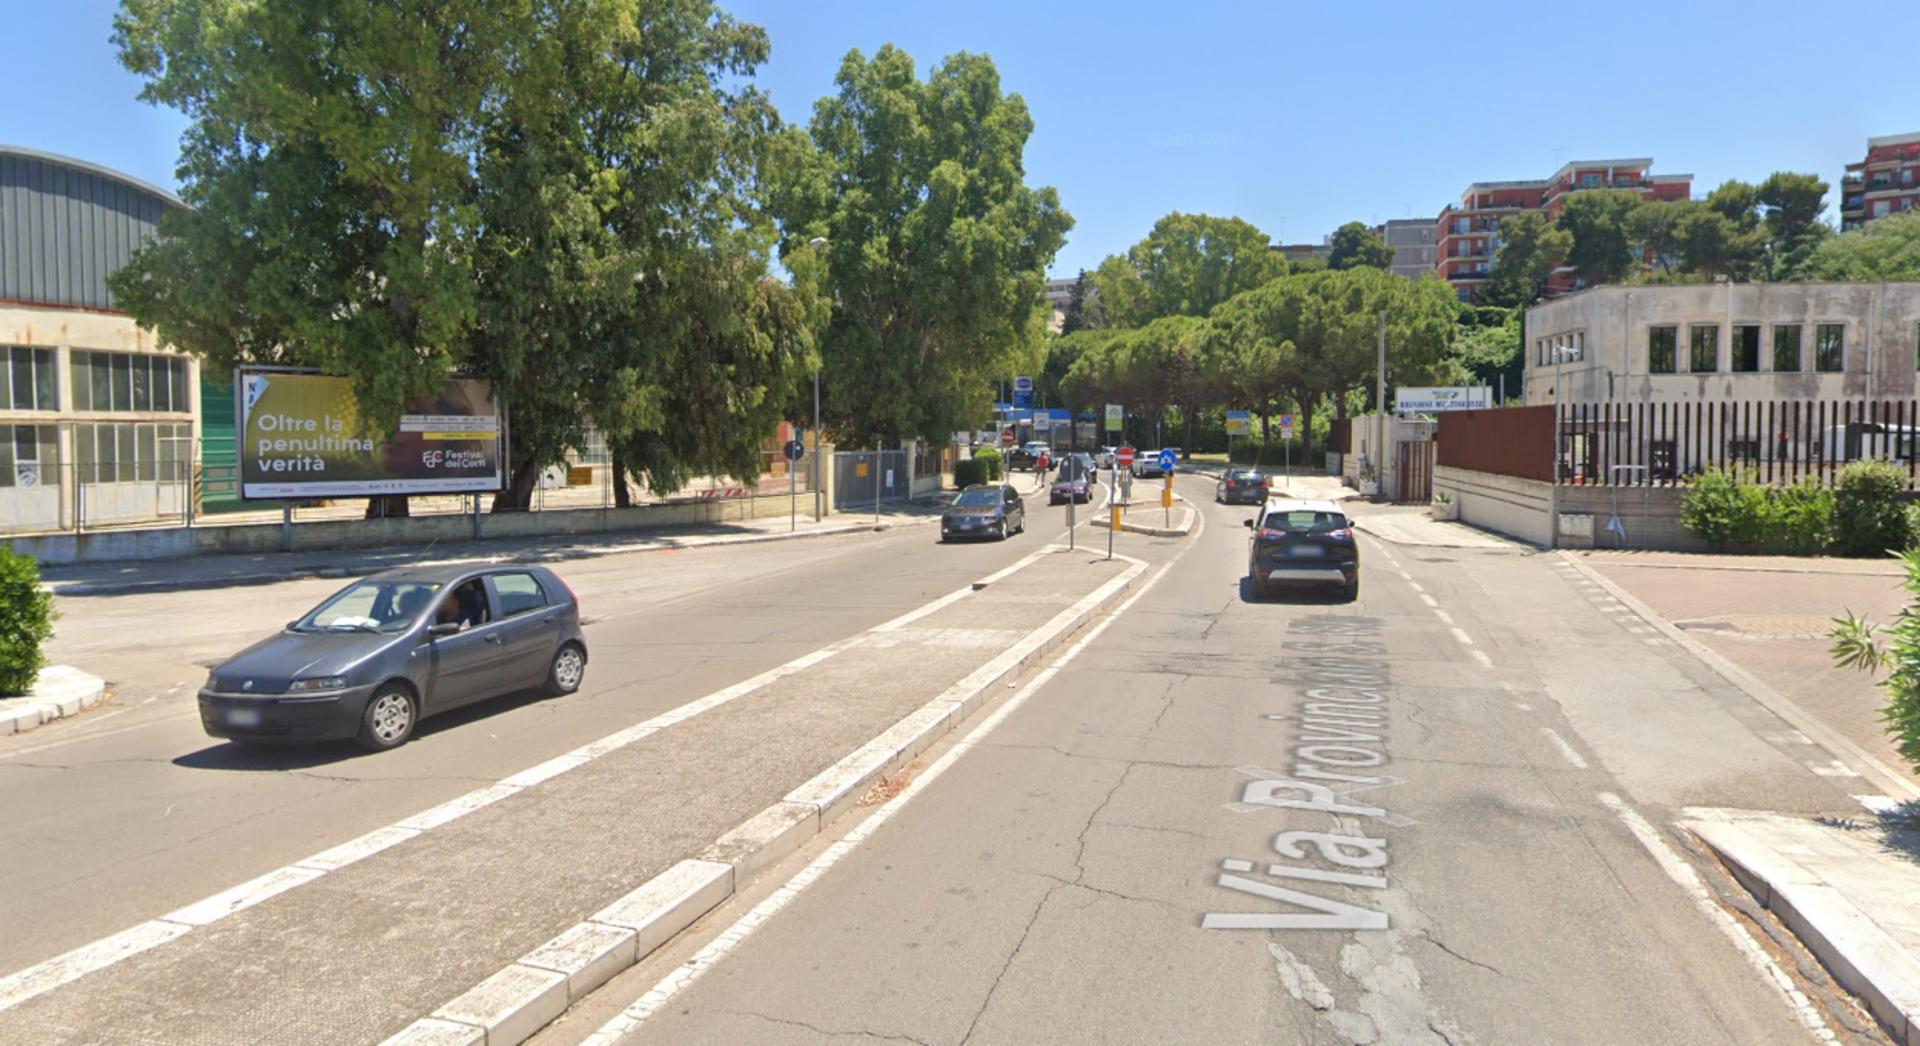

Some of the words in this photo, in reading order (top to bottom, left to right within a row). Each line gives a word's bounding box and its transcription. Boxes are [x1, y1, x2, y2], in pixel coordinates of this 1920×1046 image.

[257, 414, 317, 432] Oltre
[324, 415, 344, 432] la
[258, 432, 374, 457] penultima
[258, 453, 325, 472] verità
